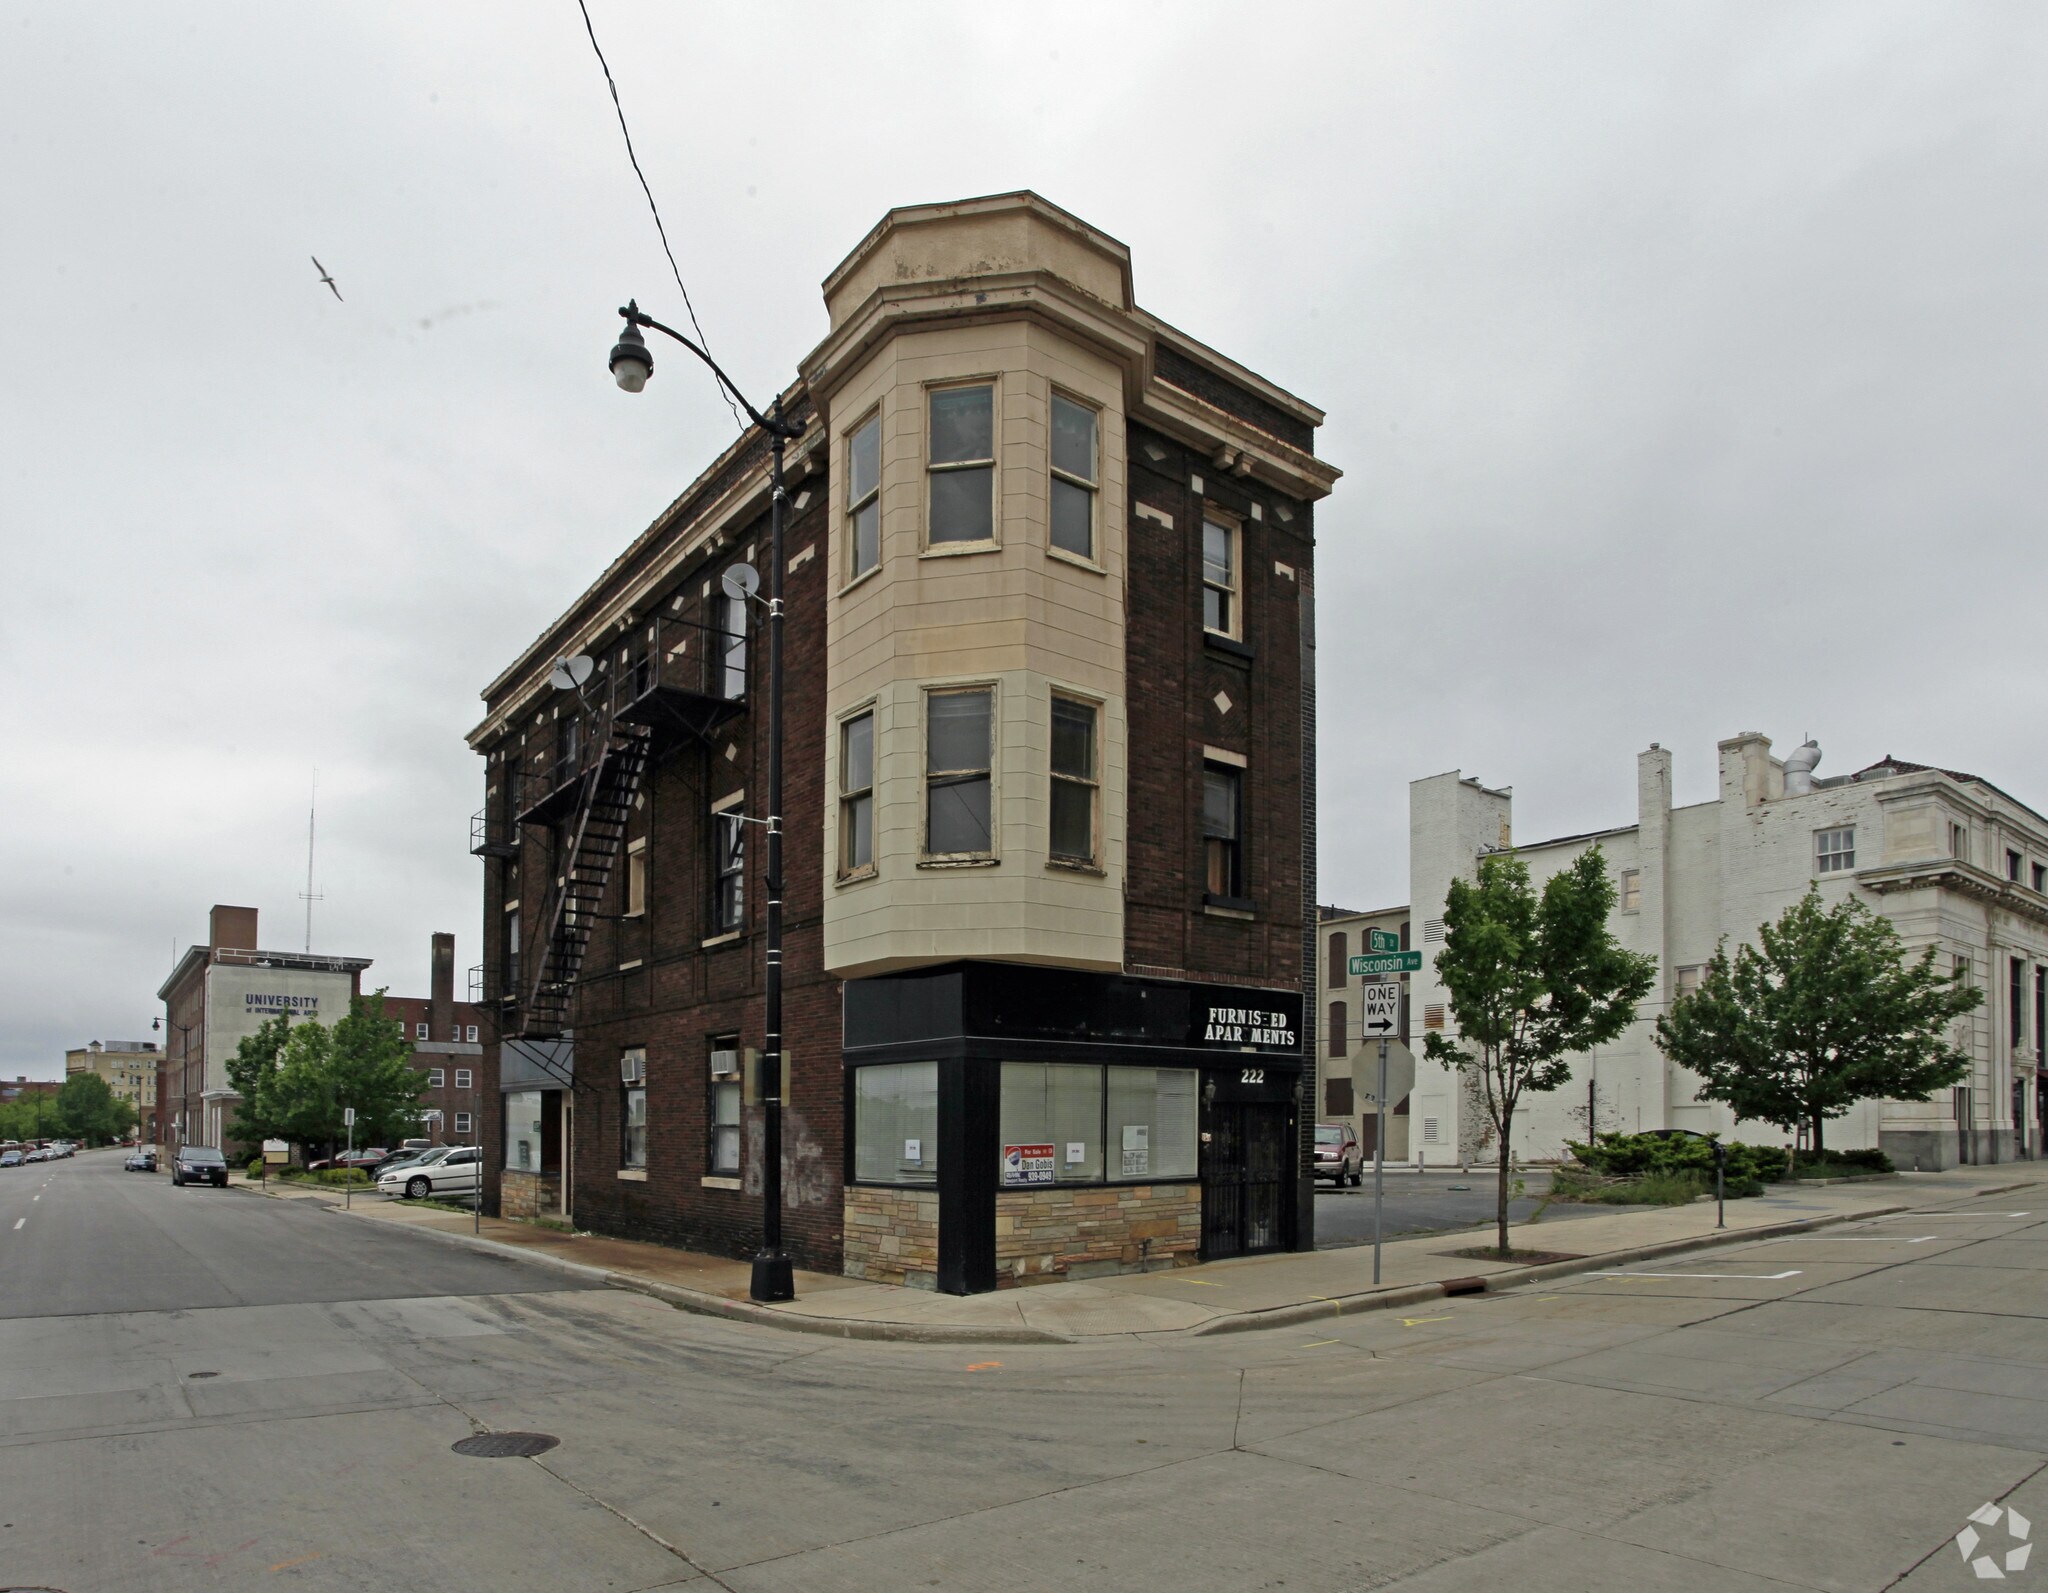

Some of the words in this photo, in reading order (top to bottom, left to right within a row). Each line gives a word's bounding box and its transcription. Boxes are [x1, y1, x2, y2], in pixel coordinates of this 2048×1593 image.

[1373, 933, 1385, 949] 5th
[1352, 955, 1403, 974] Wisconsin
[1407, 957, 1418, 966] Ave
[1368, 987, 1395, 1000] ONE
[246, 994, 318, 1008] UNIVERSITY
[255, 1007, 300, 1016] INTERNATNAL
[1367, 1002, 1396, 1015] WAY
[1208, 1008, 1287, 1028] FURNISED
[1204, 1024, 1295, 1045] APARMENTS
[1241, 1069, 1264, 1084] 222
[1021, 1159, 1034, 1170] Dan
[1035, 1158, 1053, 1170] Gobis
